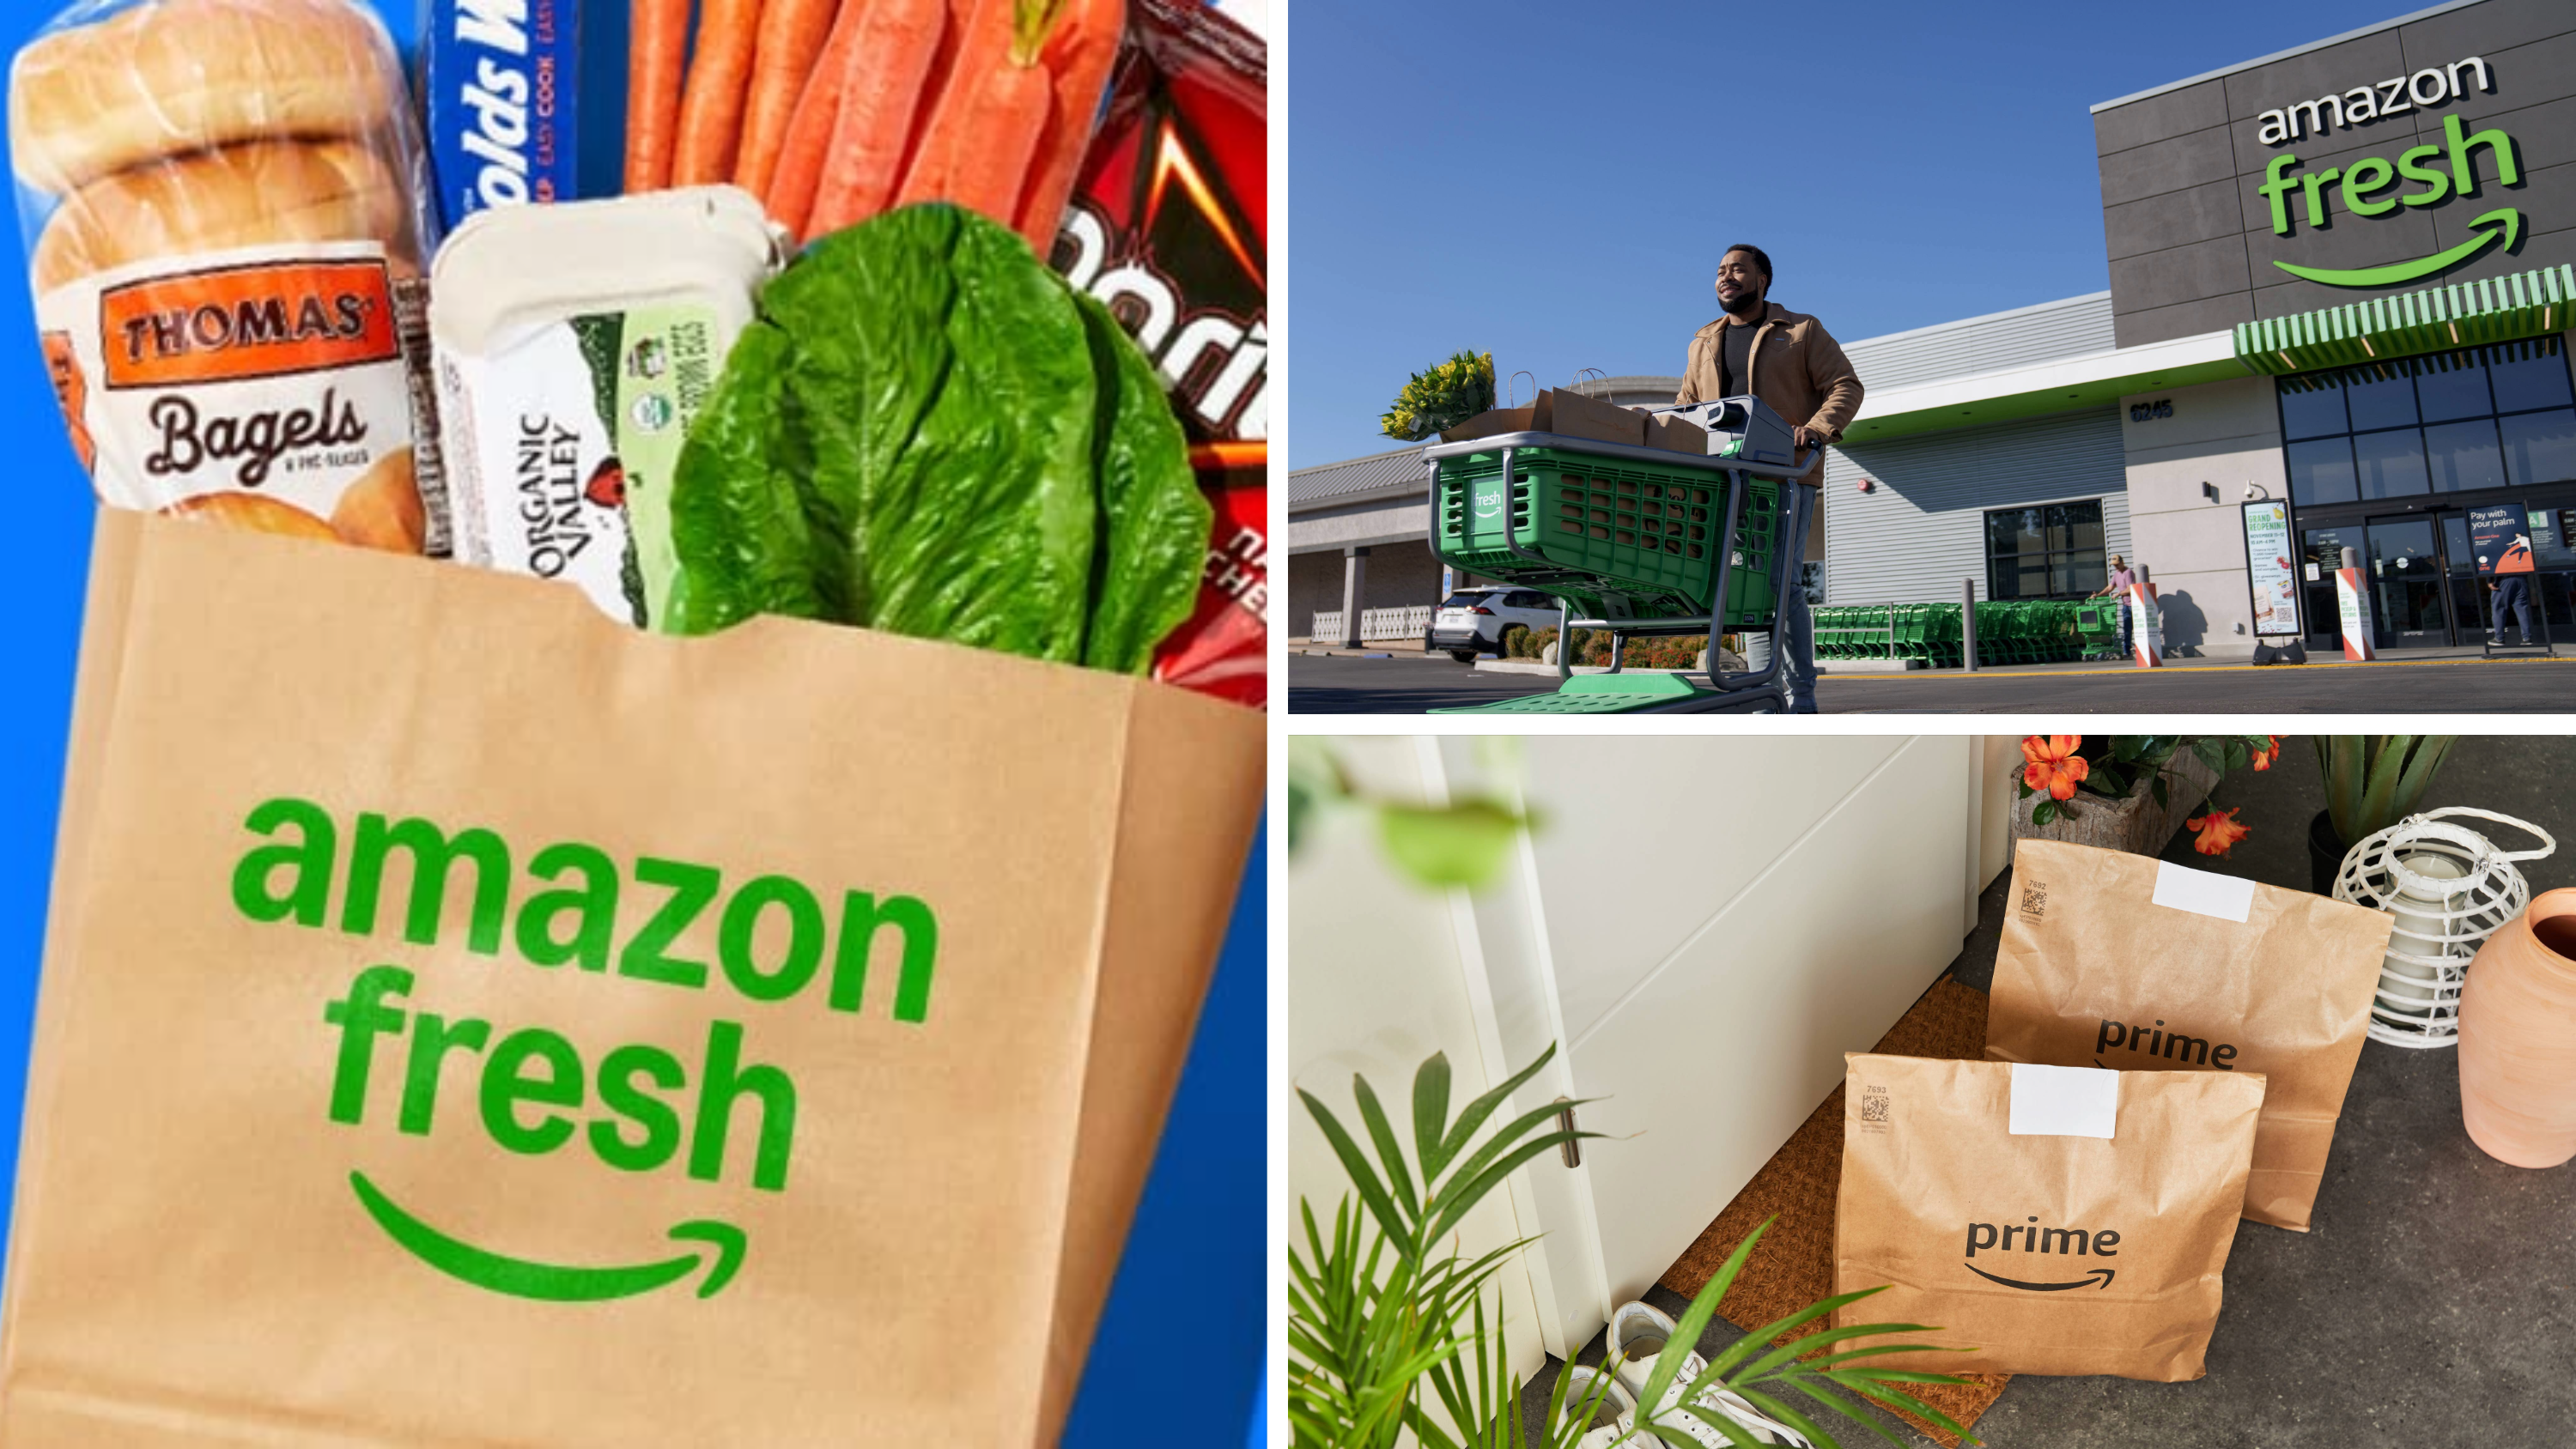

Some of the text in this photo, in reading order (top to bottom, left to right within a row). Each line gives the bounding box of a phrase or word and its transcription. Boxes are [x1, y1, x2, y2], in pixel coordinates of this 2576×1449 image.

[535, 56, 556, 117] COOK
[2258, 56, 2488, 145] amazon
[536, 122, 555, 167] EASY
[2258, 113, 2518, 234] fresh
[2130, 399, 2172, 422] 6245
[146, 387, 368, 487] Bagels
[518, 413, 567, 578] ORGANIC
[550, 423, 592, 559] VALLEY
[1474, 490, 1501, 506] fresh
[2248, 514, 2271, 524] GRAND
[2249, 522, 2286, 531] REOPENING
[2470, 509, 2506, 521] Pay with
[2471, 518, 2515, 530] your palm
[2028, 880, 2046, 890] 7692
[232, 797, 938, 1024] amazon
[2096, 1019, 2238, 1070] prime
[325, 964, 798, 1192] fresh
[1867, 1085, 1886, 1094] 7693
[1965, 1216, 2121, 1258] prime
